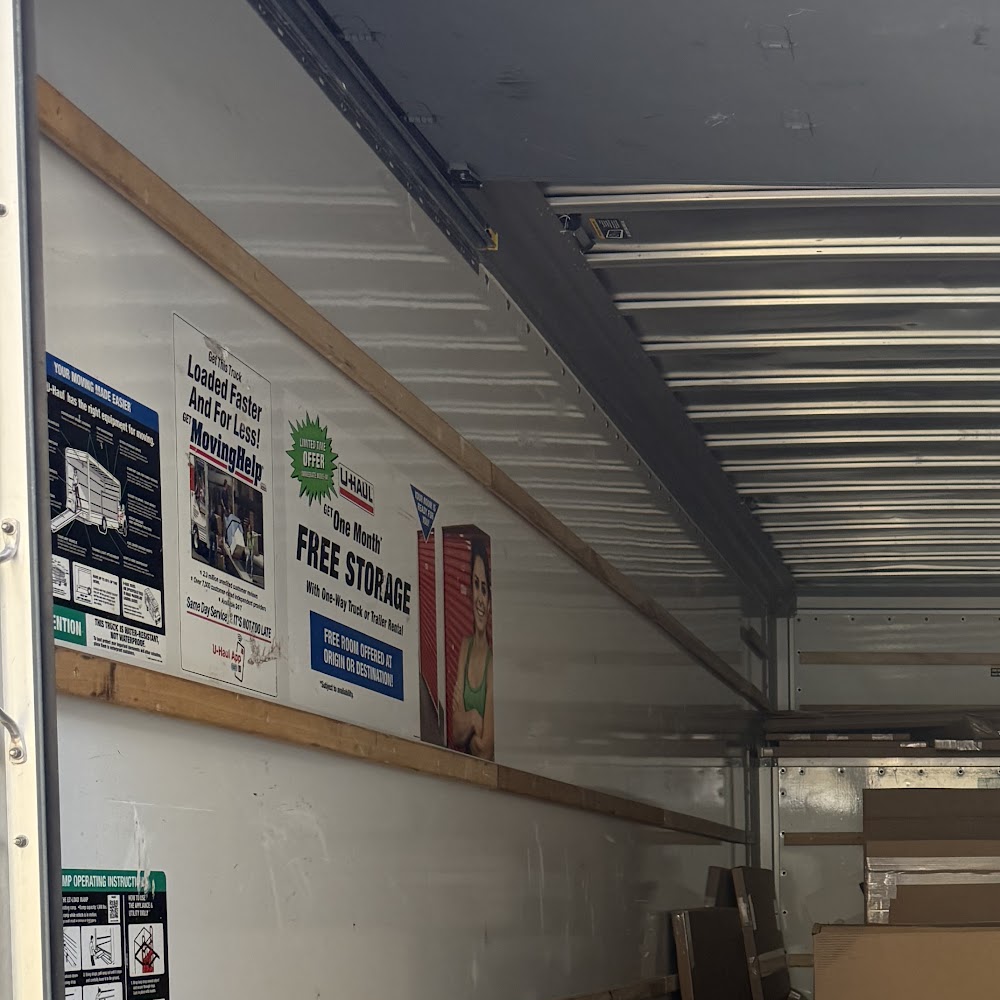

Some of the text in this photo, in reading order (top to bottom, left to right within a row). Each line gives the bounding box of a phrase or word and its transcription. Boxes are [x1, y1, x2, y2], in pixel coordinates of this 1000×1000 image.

[208, 351, 242, 383] Get This Truck
[54, 361, 131, 413] YOUR MOVING MADE EASIER
[187, 354, 262, 422] Loaded Faster
[66, 392, 77, 407] has
[78, 397, 87, 412] the
[88, 403, 101, 419] right
[101, 412, 128, 432] equipment
[128, 423, 136, 437] for
[182, 412, 192, 425] GET
[188, 386, 260, 449] And For Less!
[303, 451, 324, 469] OFFER
[340, 467, 373, 503] U-HAUL
[324, 504, 334, 518] GET
[334, 510, 350, 538] One
[194, 576, 202, 584] Over
[296, 524, 412, 615] FREE STORAGE
[186, 596, 200, 612] Same
[201, 602, 210, 618] Day
[242, 618, 252, 630] NOT
[252, 622, 261, 634] TOO
[261, 626, 272, 638] LATE
[306, 580, 404, 636] With One-Way Truck or Trailer Rental
[105, 620, 118, 632] TRUCK
[120, 625, 124, 633] IS
[110, 632, 118, 640] NOT
[212, 644, 242, 664] U-Haul App
[324, 628, 392, 669] FREE ROOM OFFERED AT
[324, 648, 394, 688] ORIGIN OR DESTINATION!
[73, 875, 106, 887] OPERATING
[108, 876, 145, 888] INSTRUCTI
